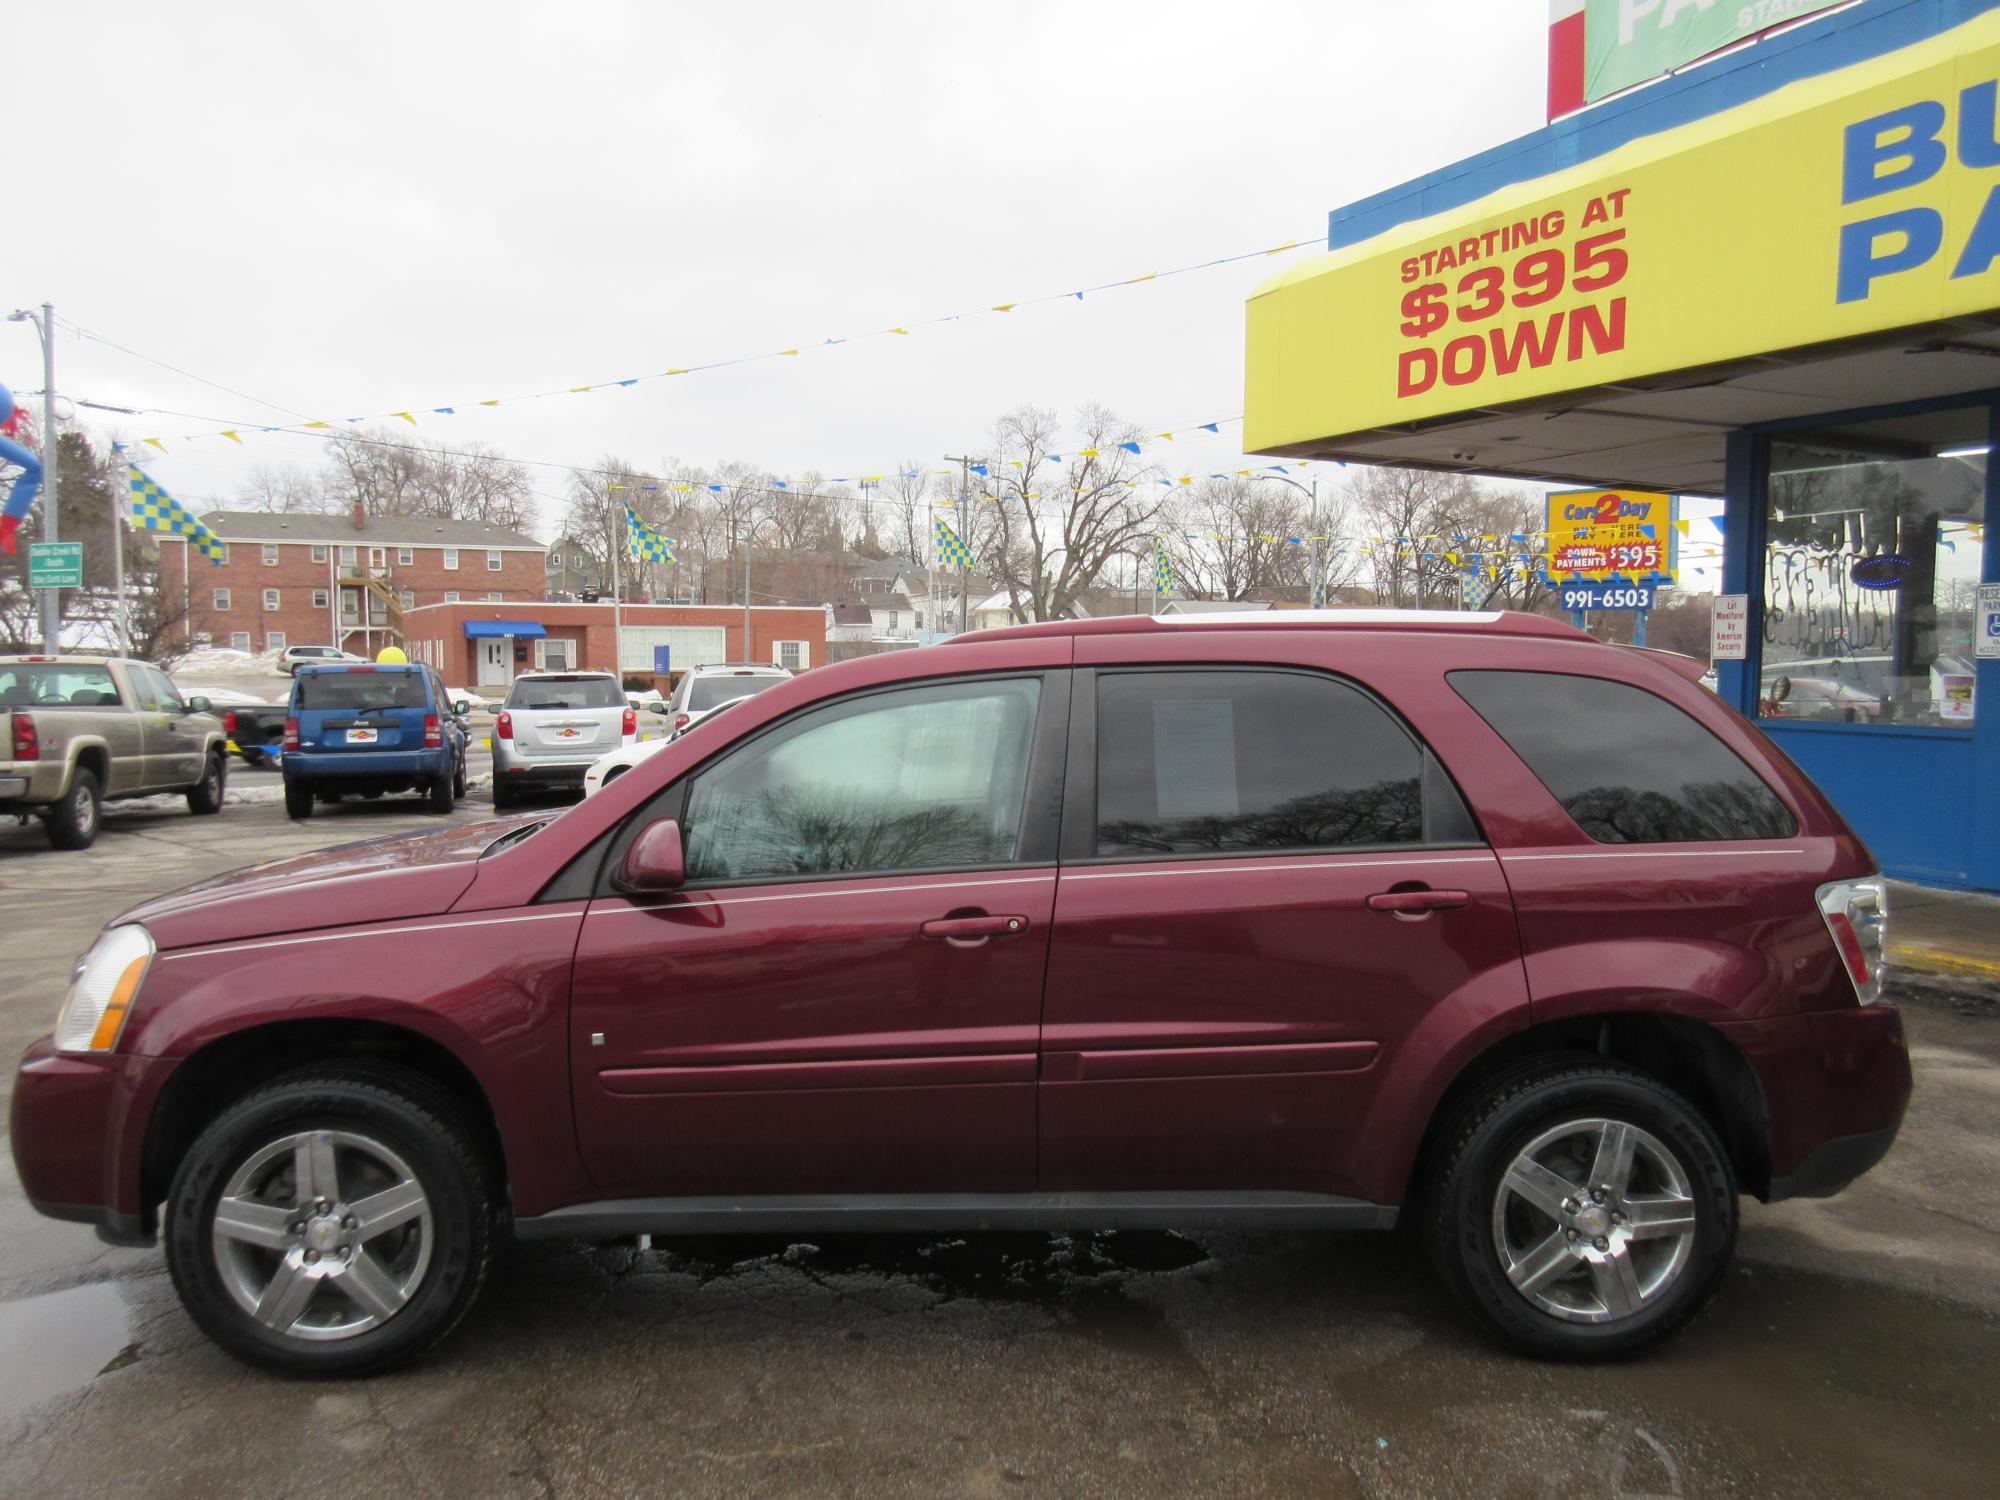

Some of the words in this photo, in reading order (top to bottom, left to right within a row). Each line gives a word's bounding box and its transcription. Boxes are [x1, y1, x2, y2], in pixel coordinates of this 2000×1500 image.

[1401, 210, 1565, 283] STARTING
[1581, 188, 1631, 229] AT
[1400, 228, 1628, 339] $395
[1397, 296, 1627, 399] DOWN
[1557, 557, 1607, 569] PAYMENTS
[1565, 589, 1649, 608] 991-6503
[1728, 622, 1735, 631] by
